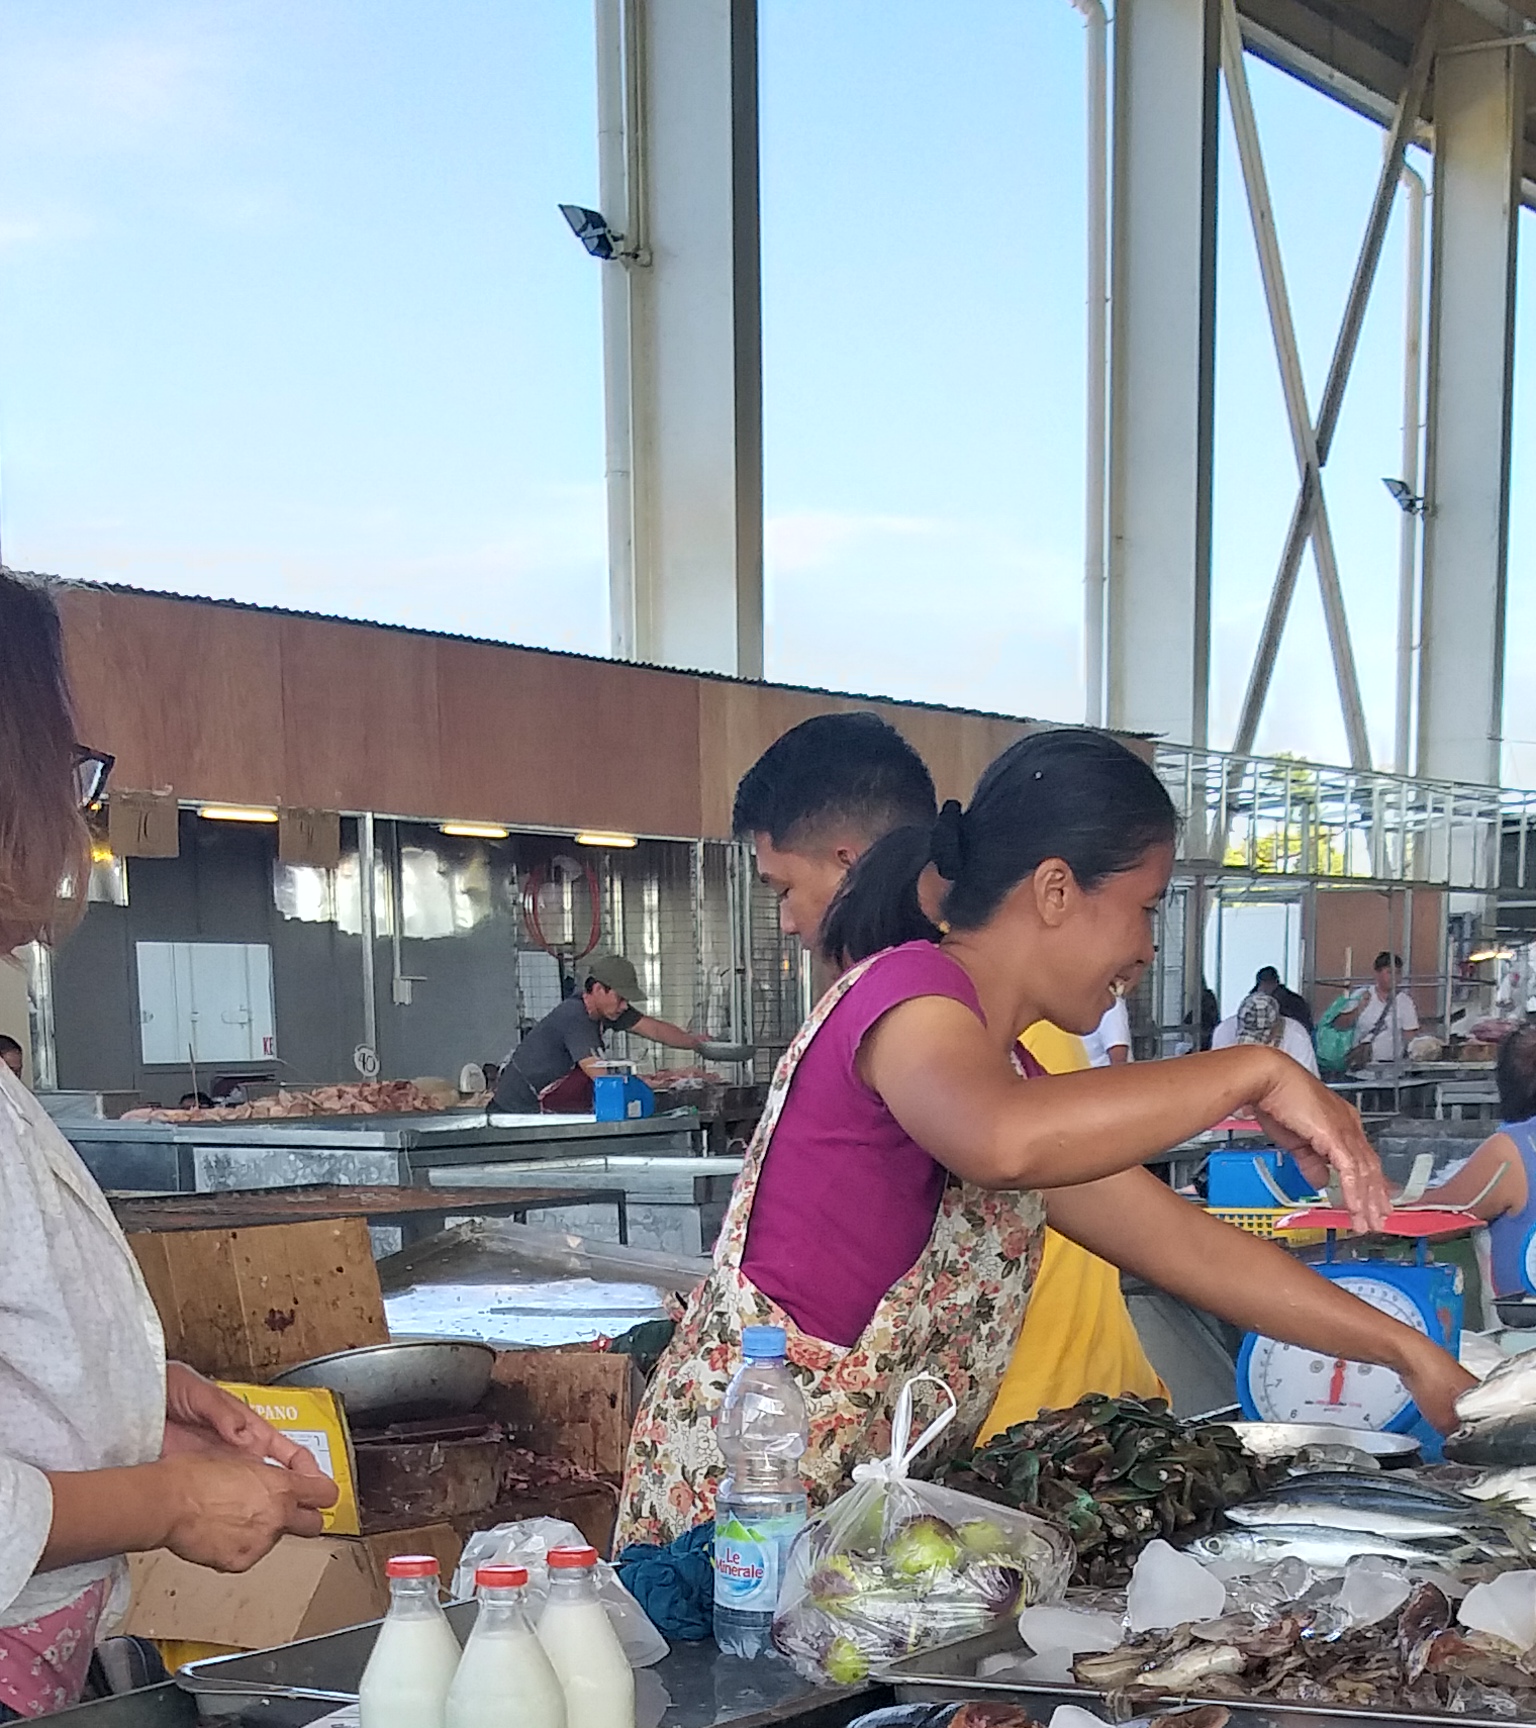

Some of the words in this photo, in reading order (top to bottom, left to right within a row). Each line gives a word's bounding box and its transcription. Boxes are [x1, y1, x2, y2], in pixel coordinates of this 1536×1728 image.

[1289, 1408, 1298, 1419] 6
[726, 1547, 740, 1565] Le
[715, 1557, 764, 1579] Minerale
